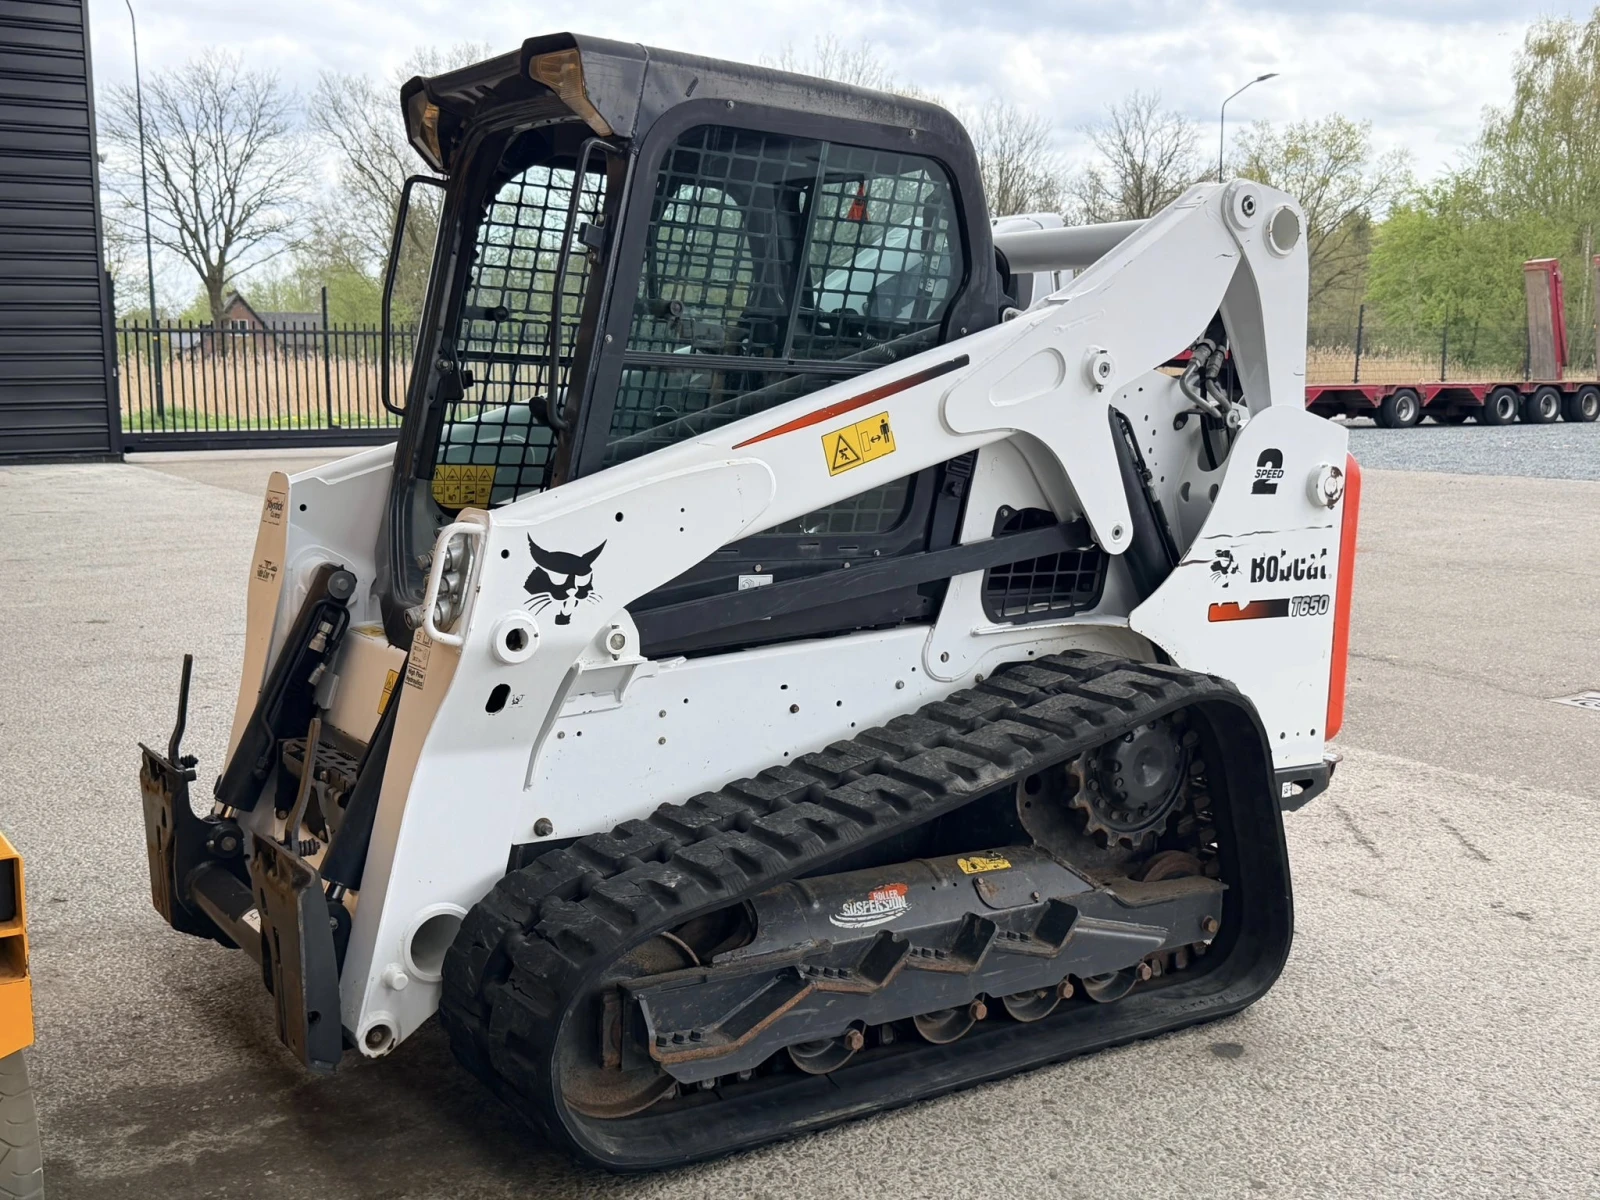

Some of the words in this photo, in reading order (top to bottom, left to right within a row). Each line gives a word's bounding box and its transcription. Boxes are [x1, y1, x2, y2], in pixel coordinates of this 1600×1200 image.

[1254, 468, 1285, 479] SPEED
[1291, 594, 1330, 617] T650
[406, 675, 424, 687] Hydraulics
[873, 889, 899, 900] ROLLER
[842, 895, 907, 915] SUSPENSION
